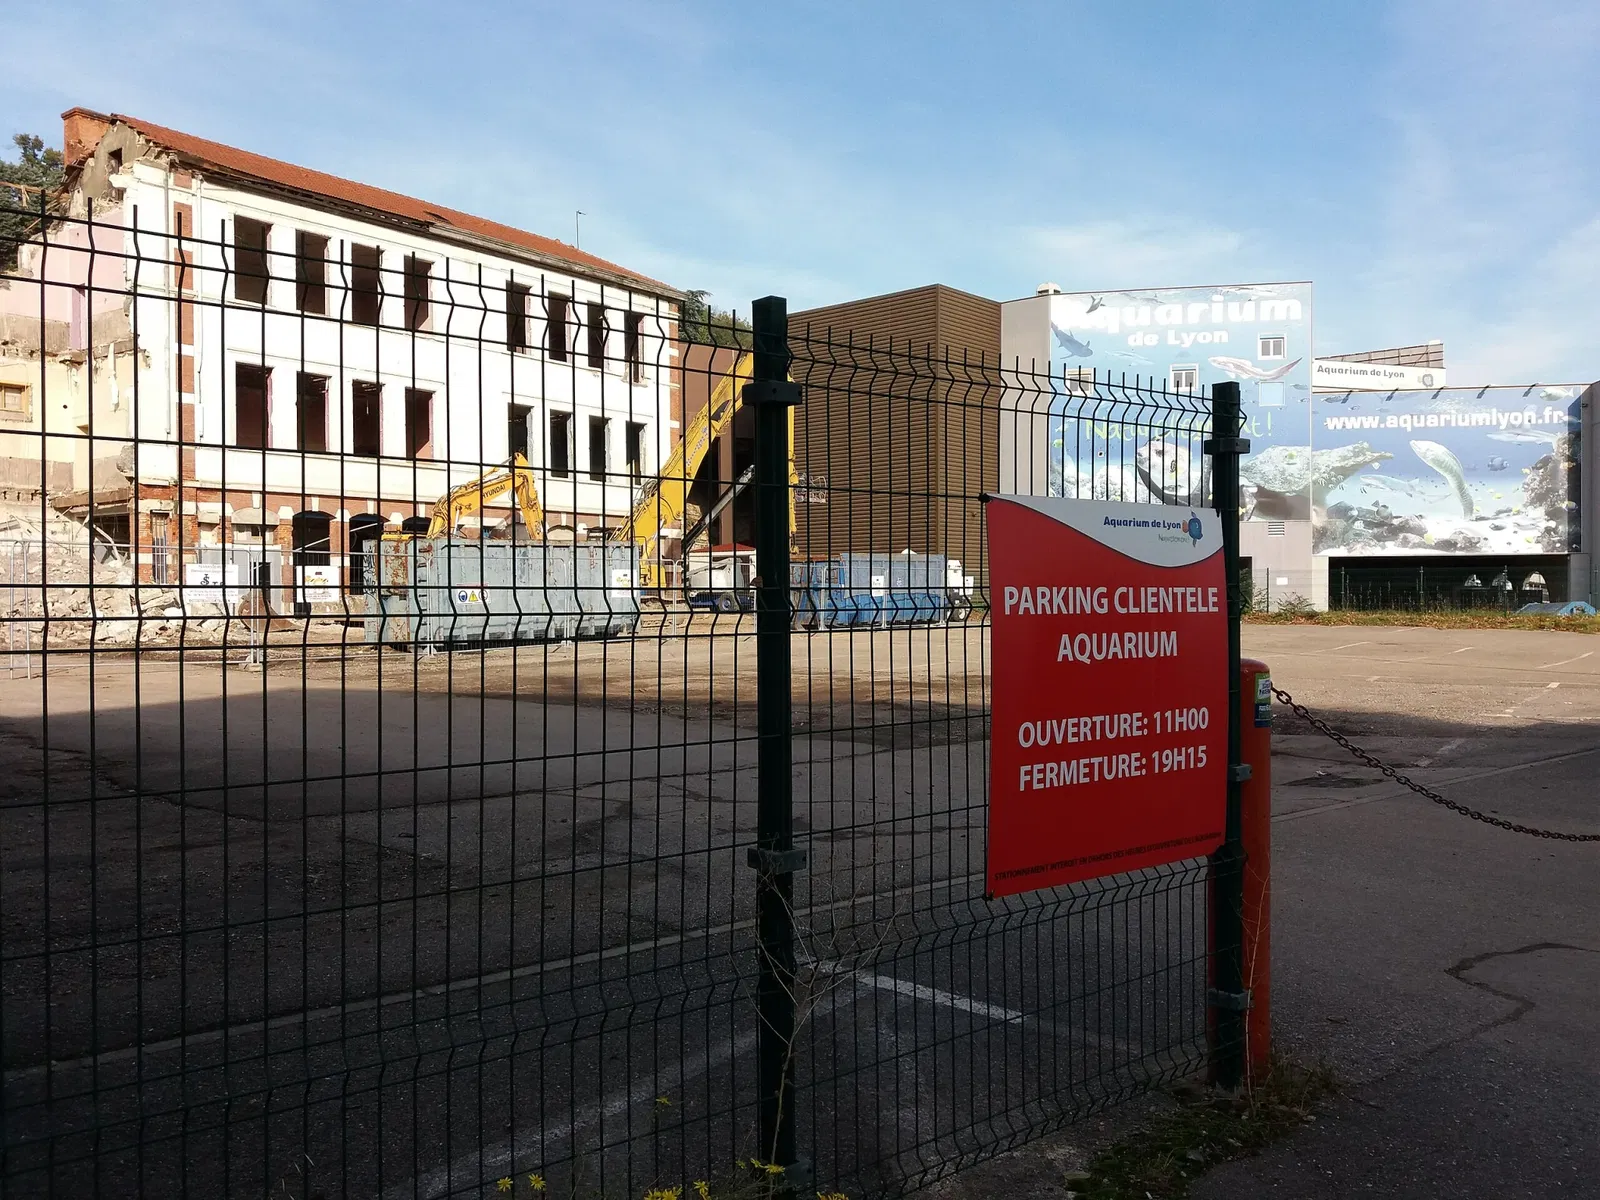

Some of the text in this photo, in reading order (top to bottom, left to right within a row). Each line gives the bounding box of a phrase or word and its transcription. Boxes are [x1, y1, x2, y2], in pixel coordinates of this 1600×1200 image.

[1127, 329, 1229, 348] de Lyon
[1317, 364, 1405, 380] Aquarium de Lyon
[1326, 406, 1564, 432] www.aquariumlyon.fr
[1103, 516, 1181, 531] Aquarium de Lyon
[1004, 586, 1219, 616] PARKING CLIENTELE
[1057, 630, 1179, 665] AQUARIUM
[1018, 706, 1210, 748] OUVERTURE: 11H00
[1019, 744, 1208, 792] FERMETURE: 19H15
